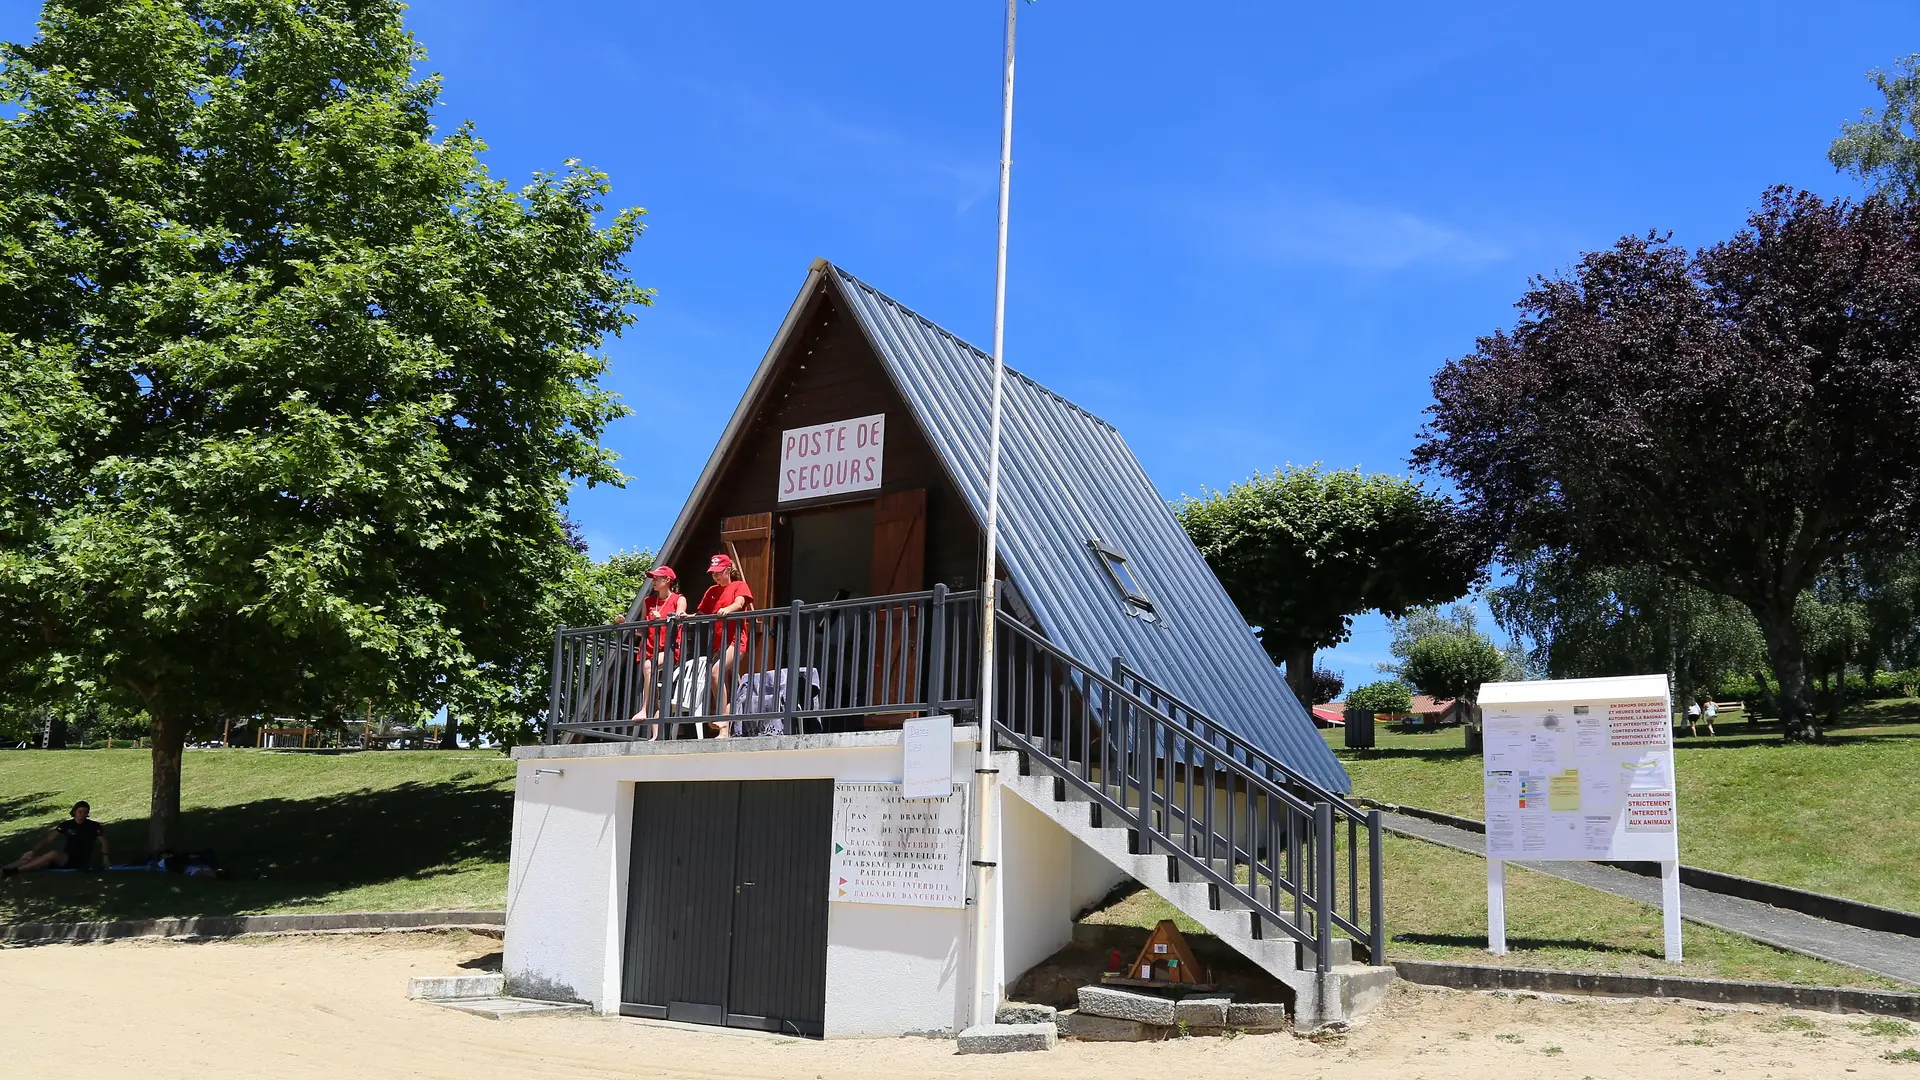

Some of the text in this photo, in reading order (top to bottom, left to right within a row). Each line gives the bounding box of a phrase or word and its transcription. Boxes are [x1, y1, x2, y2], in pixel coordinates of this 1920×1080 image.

[786, 422, 879, 460] POSTE DE
[784, 456, 875, 494] SECOURS
[846, 849, 889, 858] BAIGNADE
[911, 863, 944, 871] DANGER
[860, 870, 919, 878] PARTICULIER
[855, 879, 950, 891] BAIGNADE INTERDITE
[854, 891, 896, 899] BAIGNADE
